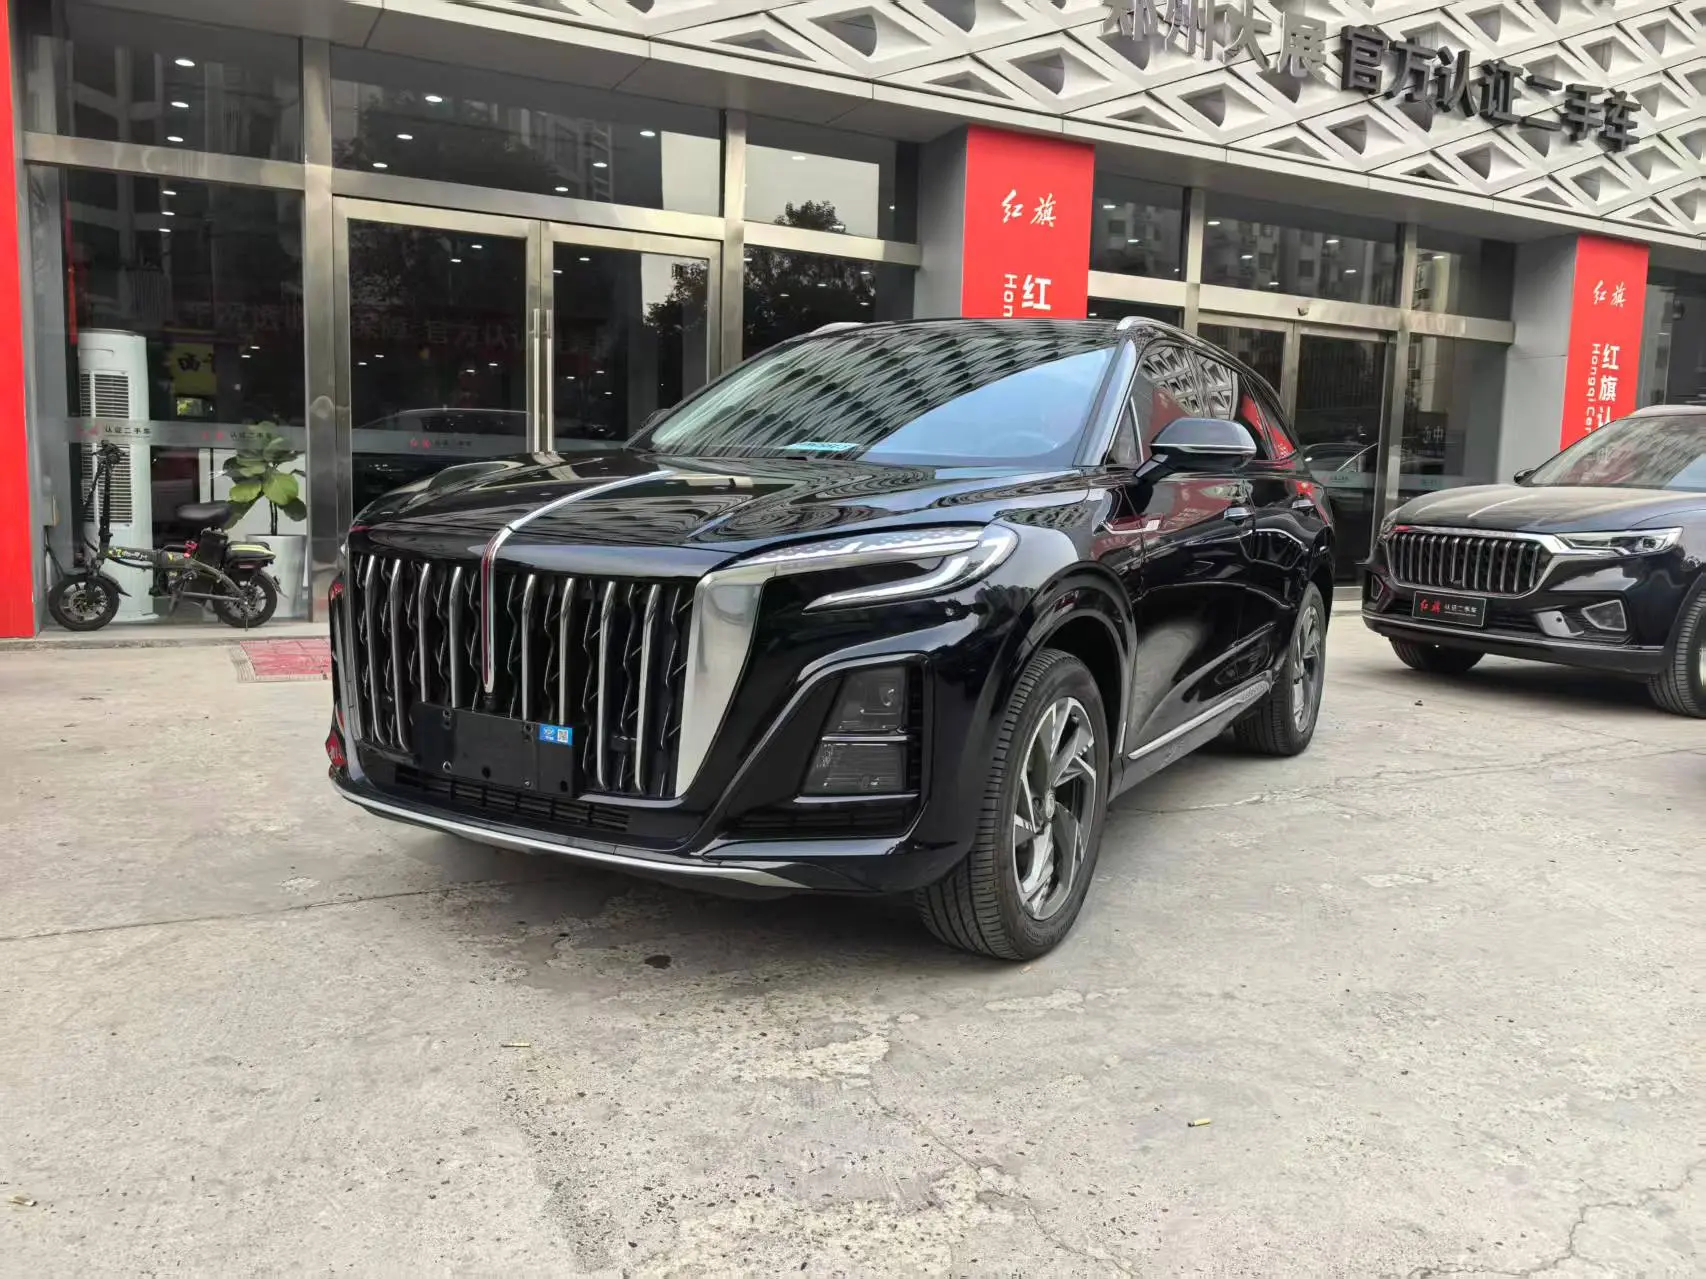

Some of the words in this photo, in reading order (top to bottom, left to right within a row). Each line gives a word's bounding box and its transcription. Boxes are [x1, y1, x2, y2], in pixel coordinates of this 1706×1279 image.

[1341, 24, 1642, 152] 官方认证二手车
[1002, 189, 1057, 227] 红旗
[1021, 274, 1052, 311] 红
[1593, 279, 1627, 307] 红旗
[1586, 343, 1601, 402] Hongqi
